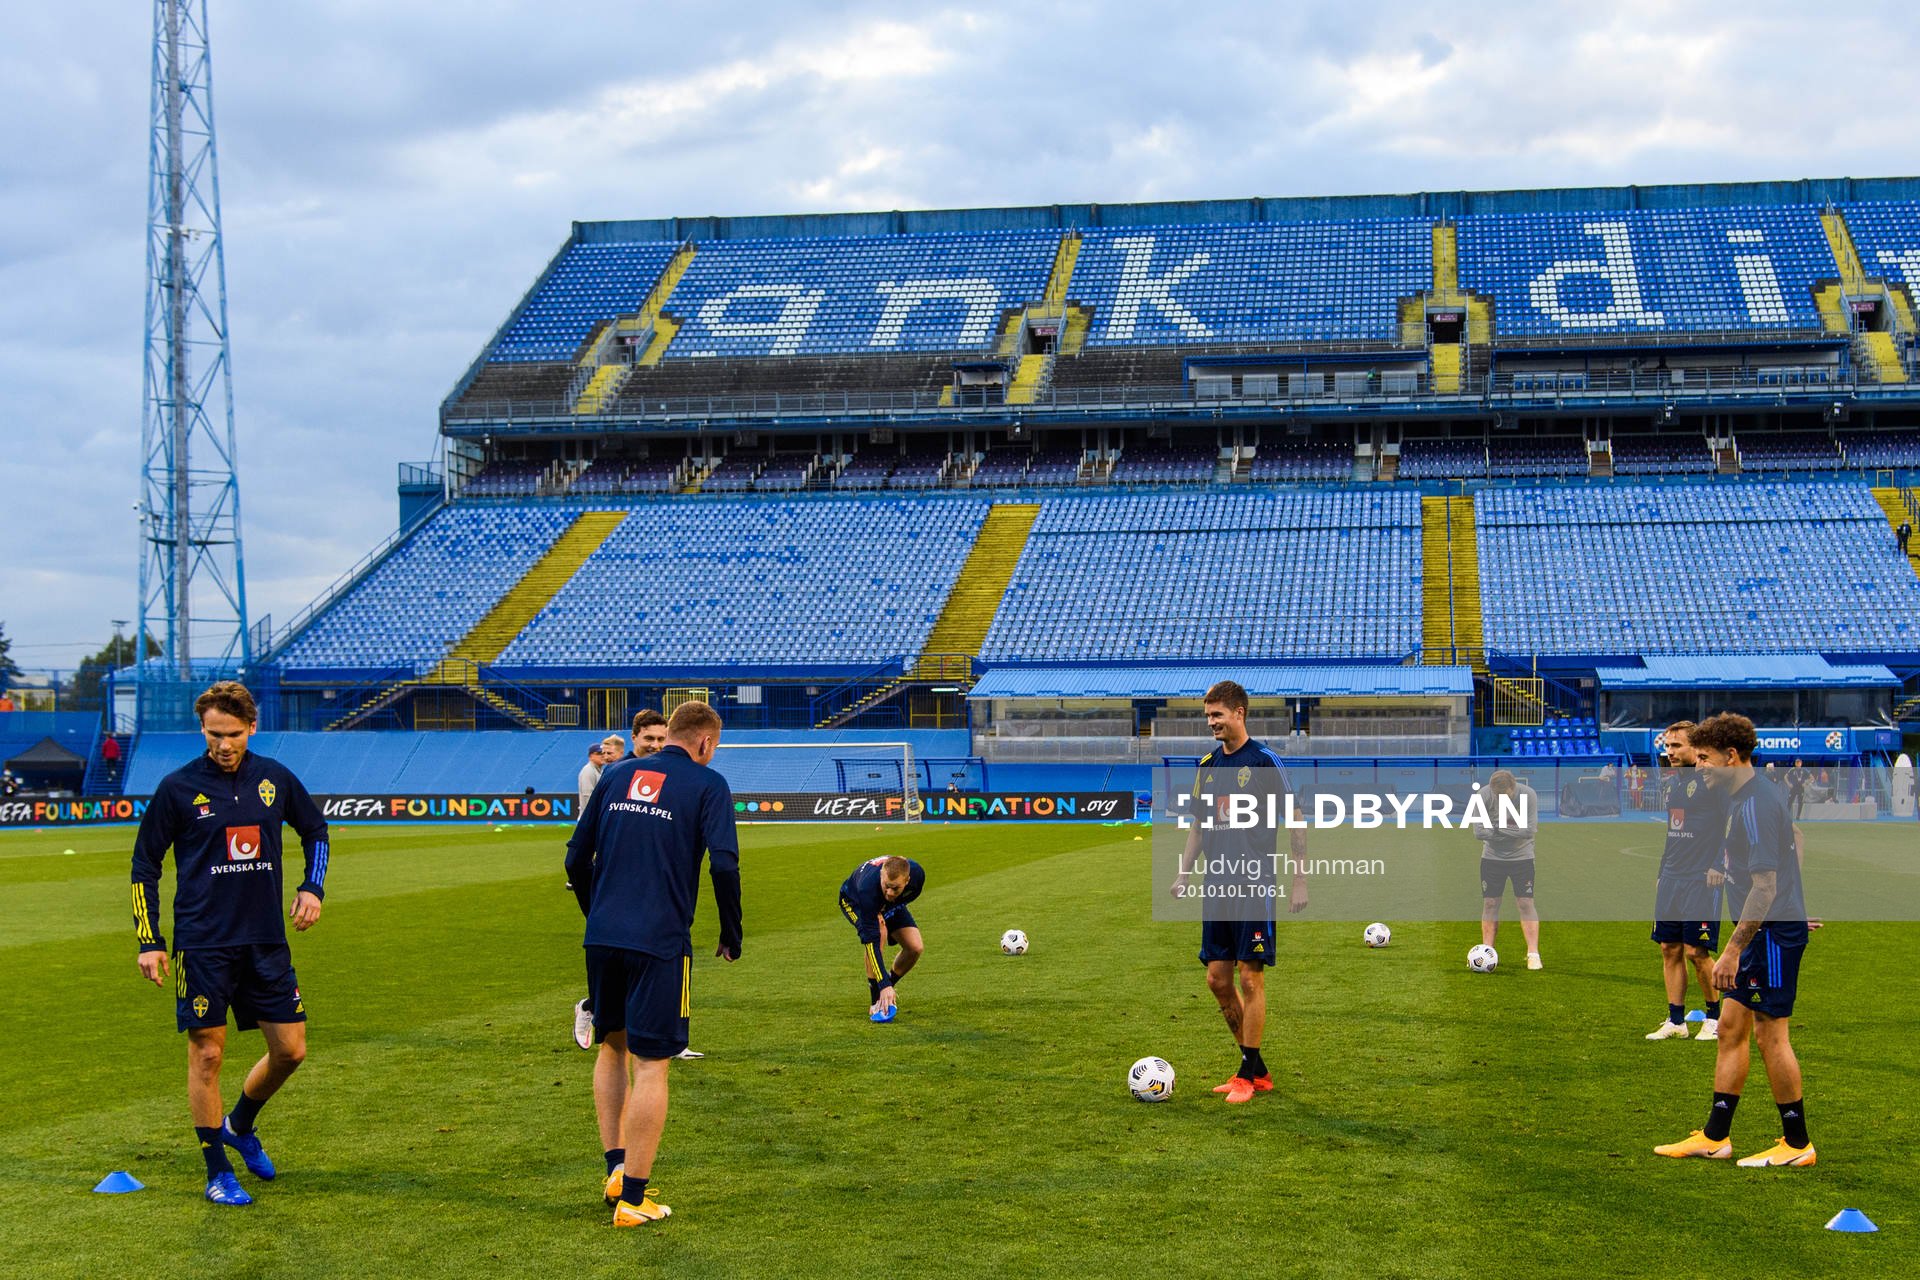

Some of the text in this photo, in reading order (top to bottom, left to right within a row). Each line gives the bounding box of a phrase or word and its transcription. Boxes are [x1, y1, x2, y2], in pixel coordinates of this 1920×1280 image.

[1754, 737, 1801, 749] namo
[0, 802, 32, 822] EFA
[323, 798, 386, 817] UEFA
[608, 802, 673, 820] SVENSKA SPEL
[813, 797, 880, 816] UEFA
[1080, 799, 1119, 817] .org
[210, 863, 254, 875] SVENSKA
